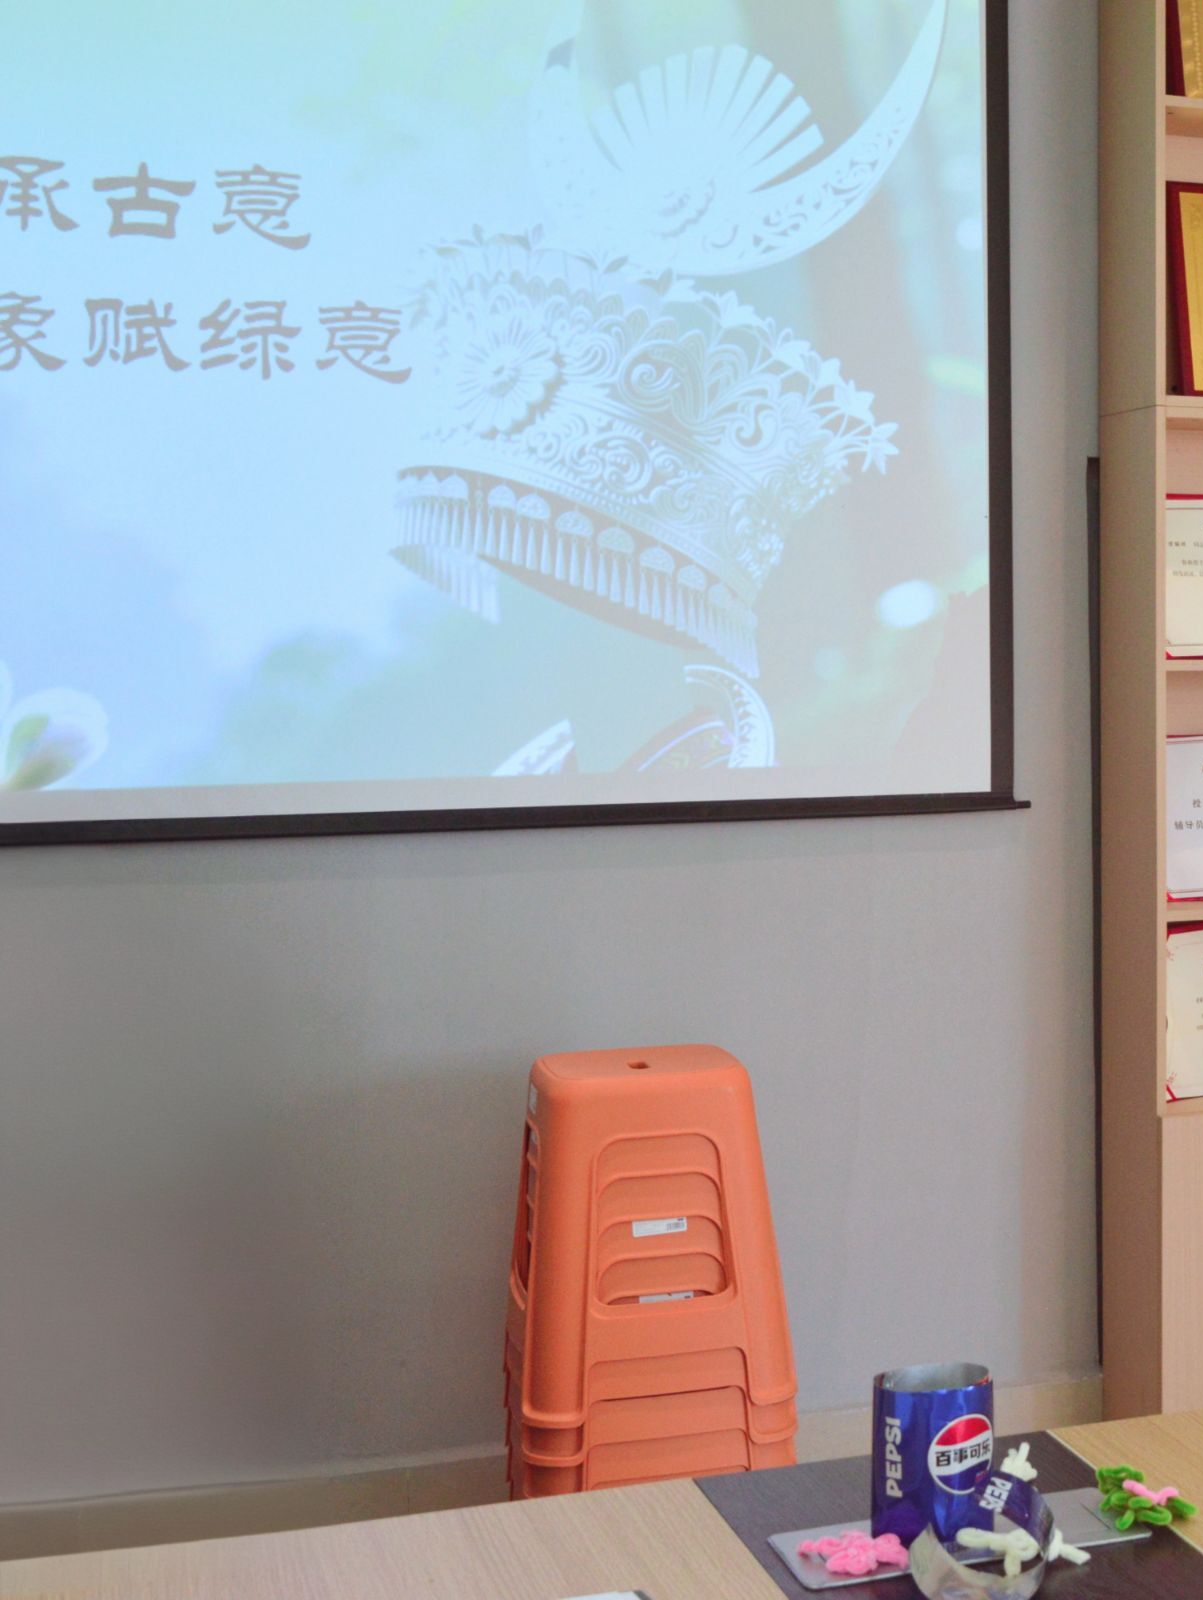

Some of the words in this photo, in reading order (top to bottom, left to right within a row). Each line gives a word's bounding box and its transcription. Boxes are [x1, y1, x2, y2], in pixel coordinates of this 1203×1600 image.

[0, 155, 311, 251] 承古意
[885, 1416, 903, 1499] PEPSI
[935, 1439, 992, 1468] 百事可乐
